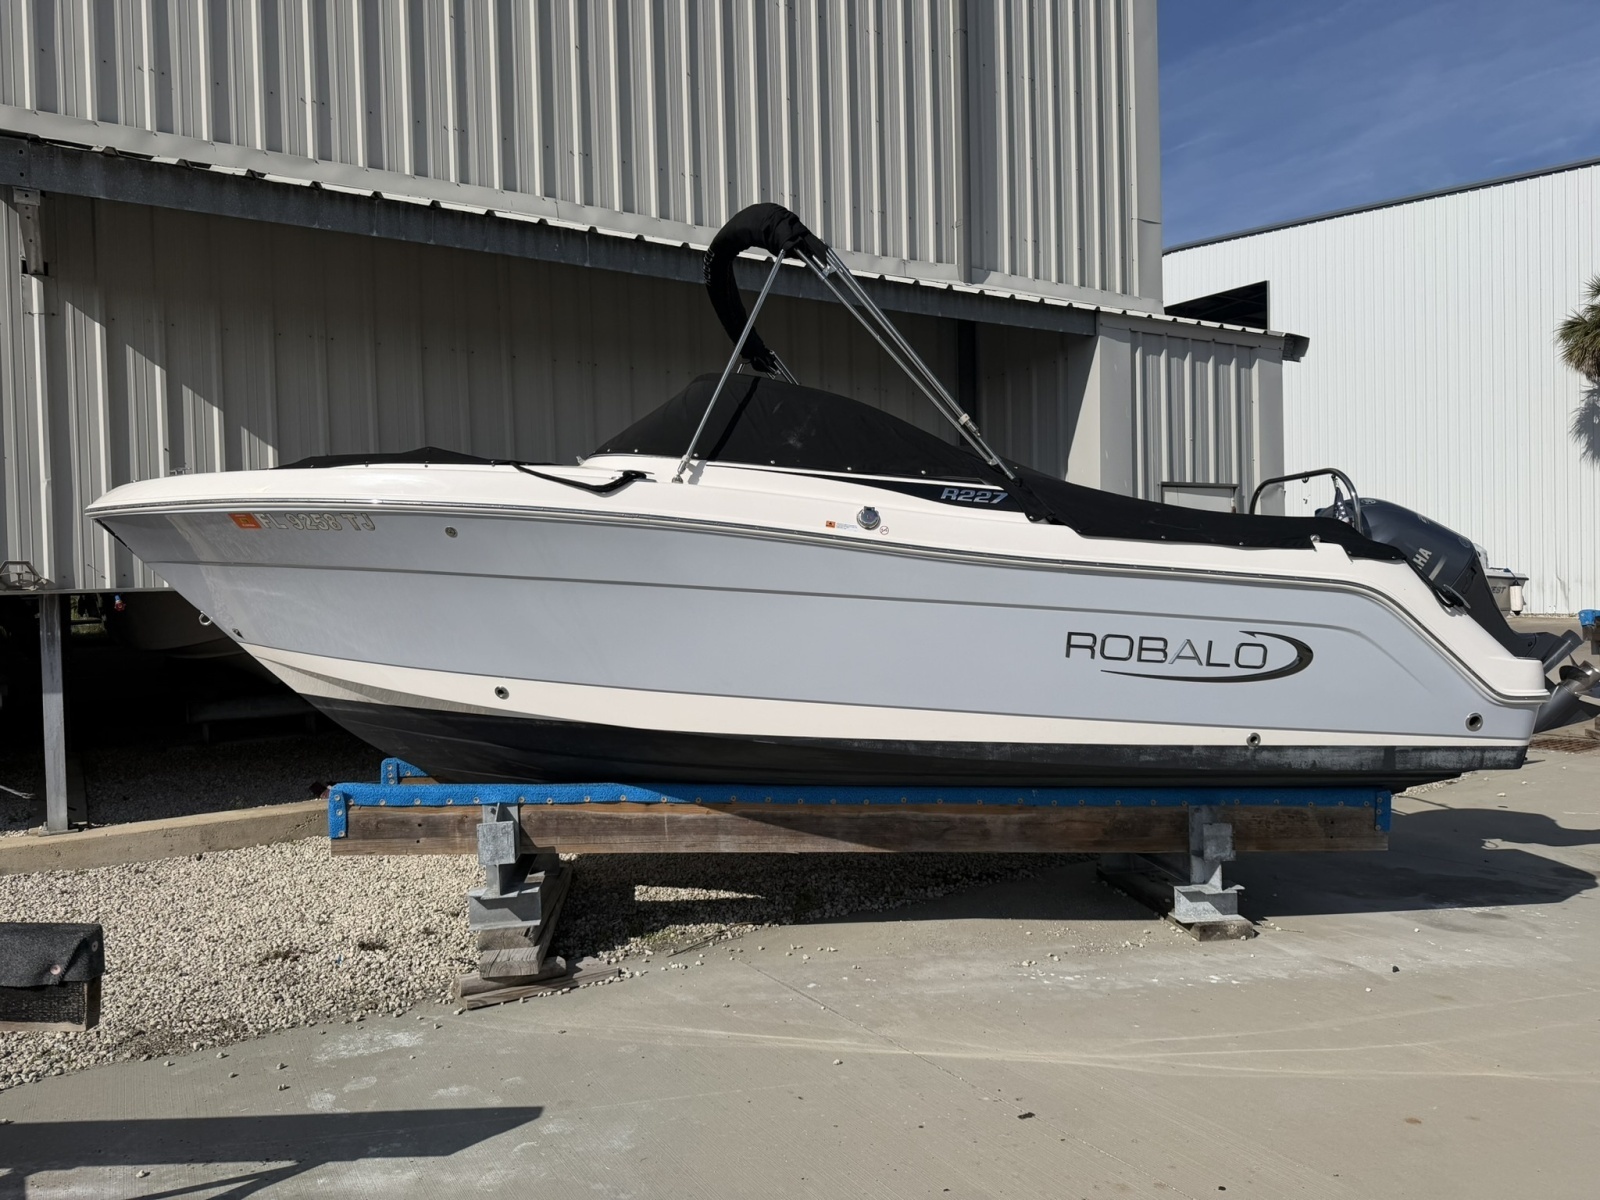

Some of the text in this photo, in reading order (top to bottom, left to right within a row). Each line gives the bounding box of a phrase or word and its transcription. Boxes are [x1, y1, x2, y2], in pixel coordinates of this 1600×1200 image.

[940, 487, 1009, 504] R227
[252, 512, 376, 531] FL 9258 TJ
[1413, 548, 1432, 570] HA
[1490, 586, 1507, 594] EST
[1065, 631, 1268, 669] ROBALO
